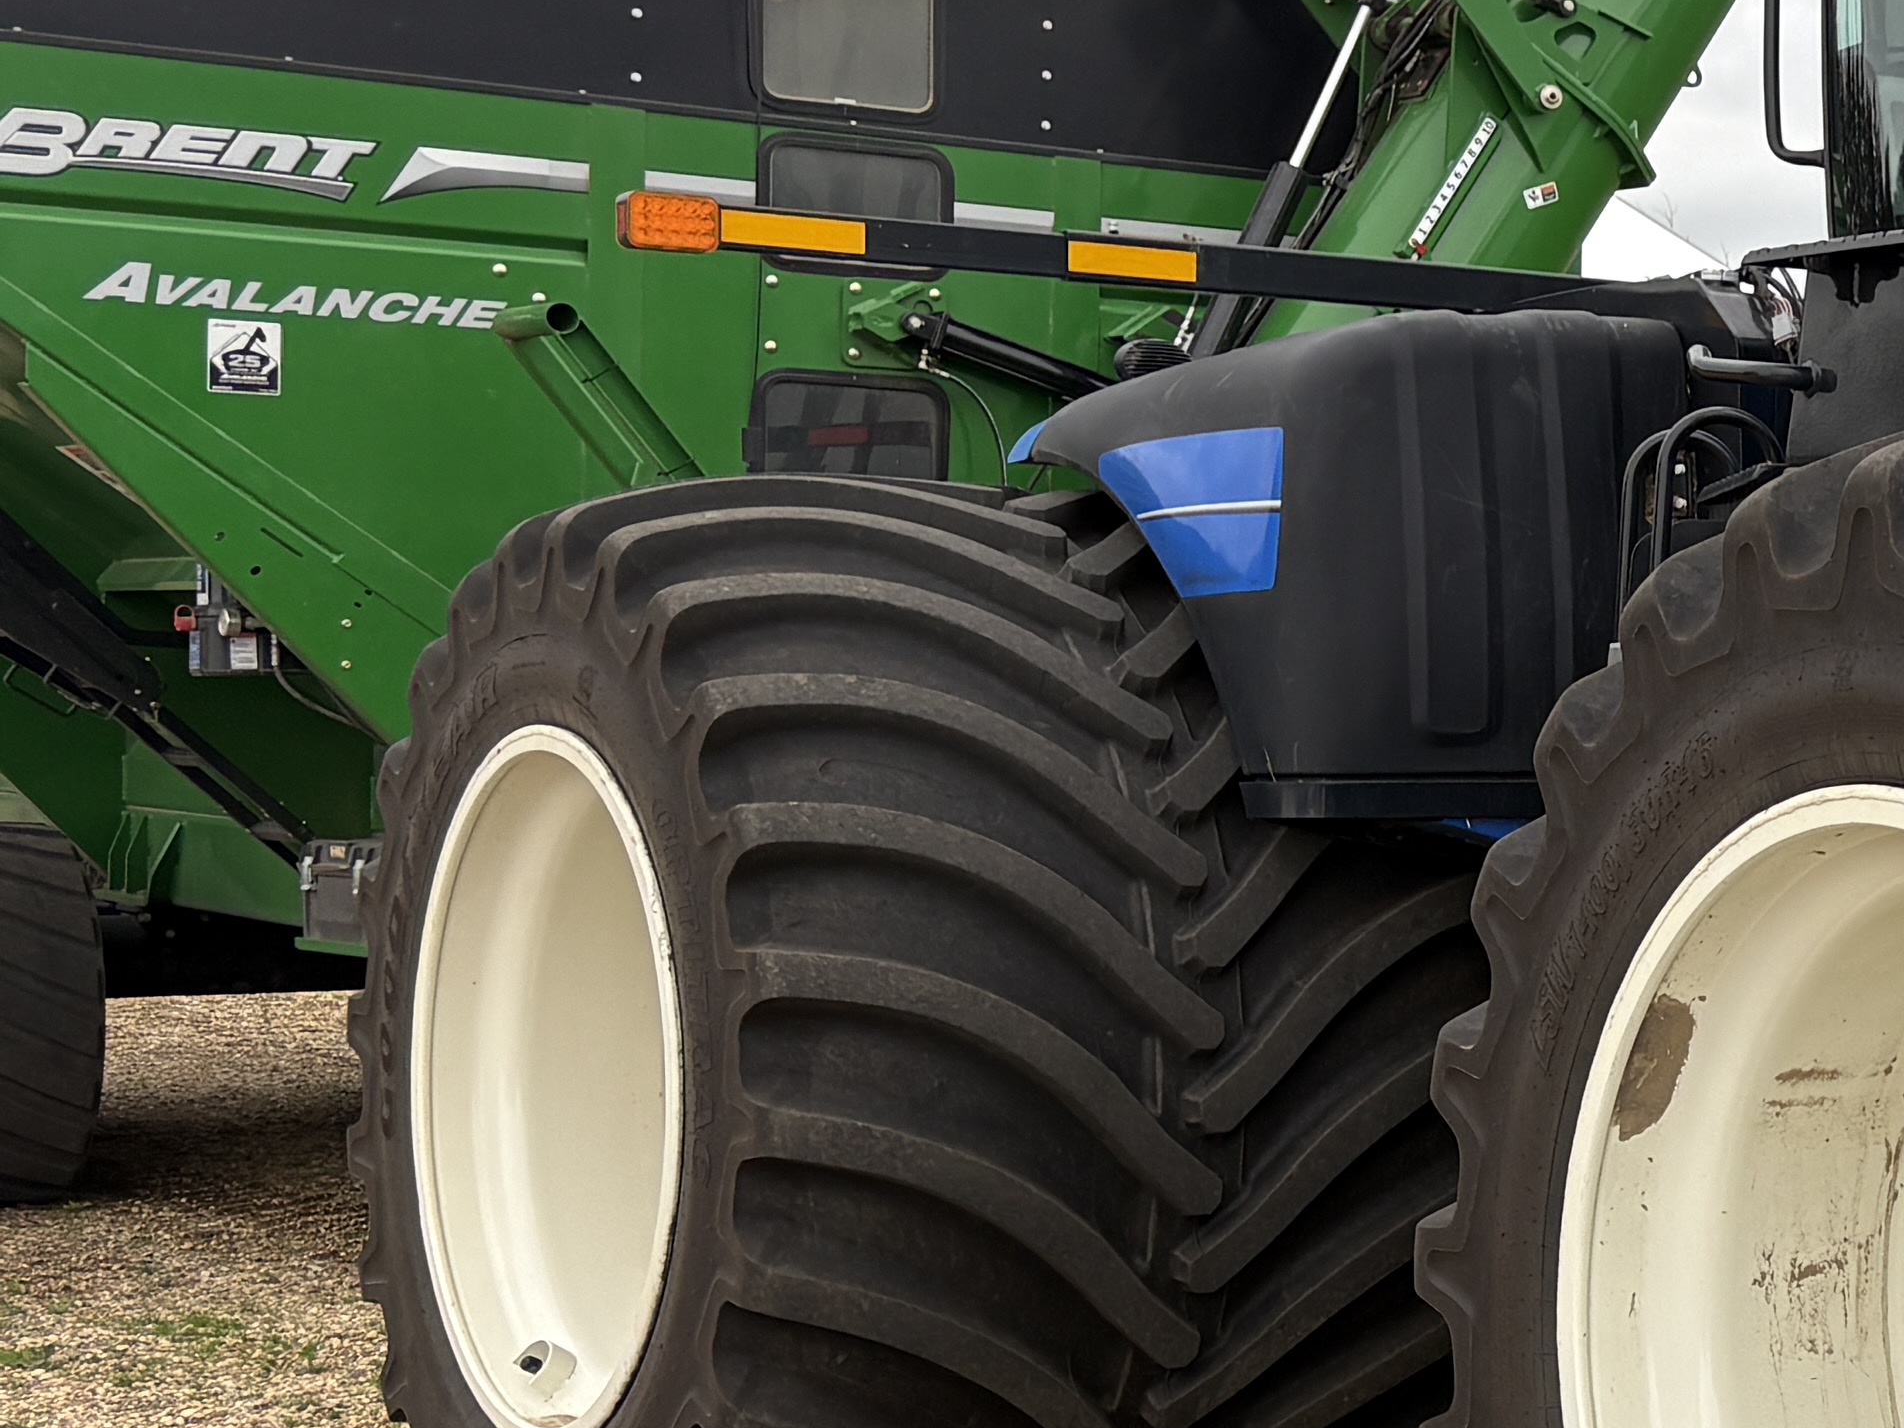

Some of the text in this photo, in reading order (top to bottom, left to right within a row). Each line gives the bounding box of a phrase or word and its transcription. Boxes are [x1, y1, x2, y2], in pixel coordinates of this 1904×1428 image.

[1418, 121, 1494, 236] 1 2 3 4 5 6 7 8 9 10
[82, 261, 509, 330] AVALANCHE
[228, 354, 261, 368] 25
[651, 797, 717, 1190] OPTITRAC
